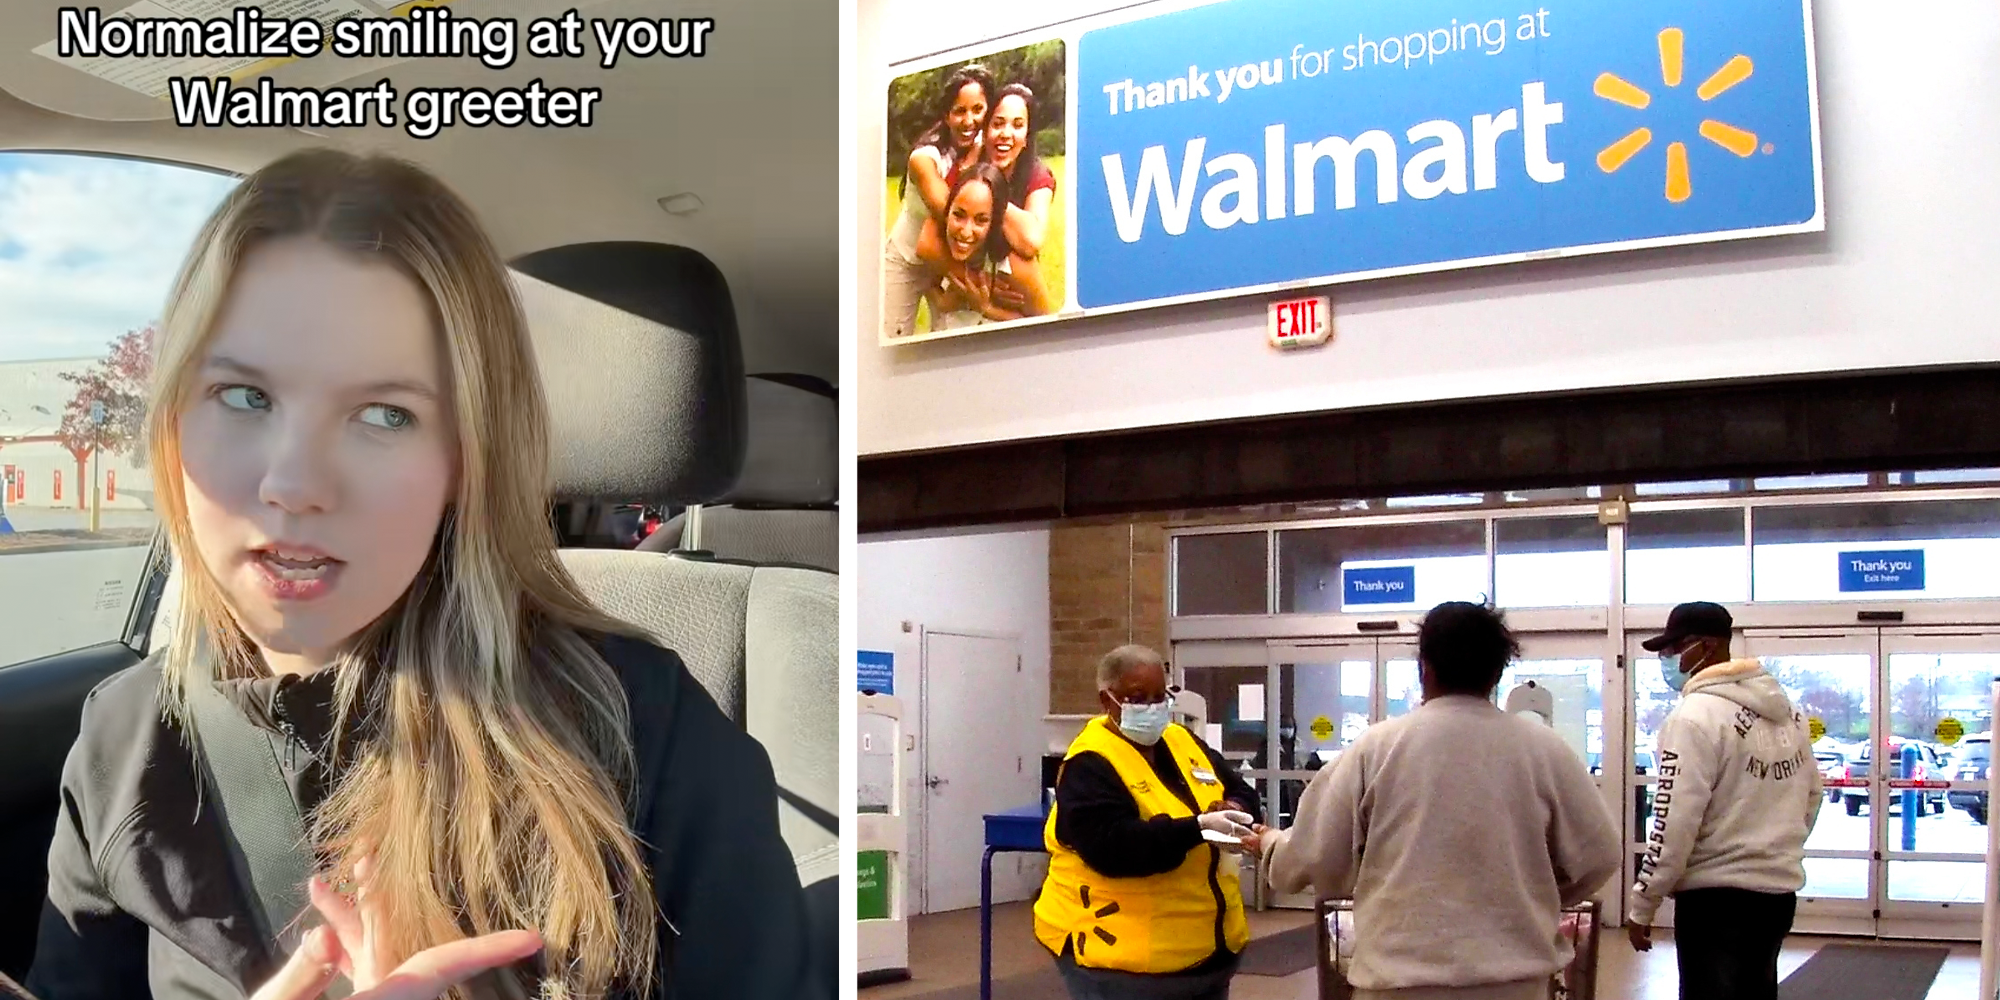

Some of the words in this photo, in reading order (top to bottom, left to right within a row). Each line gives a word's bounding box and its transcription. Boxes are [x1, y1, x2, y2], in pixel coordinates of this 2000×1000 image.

[1102, 65, 1211, 115] Thank
[1214, 58, 1283, 104] you
[1289, 43, 1335, 80] for
[1342, 18, 1506, 70] shopping
[1515, 7, 1551, 41] at
[1101, 81, 1565, 244] Walmart
[1277, 299, 1319, 338] EXIT
[1850, 559, 1888, 572] Thank
[1889, 561, 1913, 574] you
[1864, 573, 1880, 583] Exit
[1880, 573, 1900, 582] here
[1353, 579, 1385, 592] Thank
[1385, 580, 1405, 593] you
